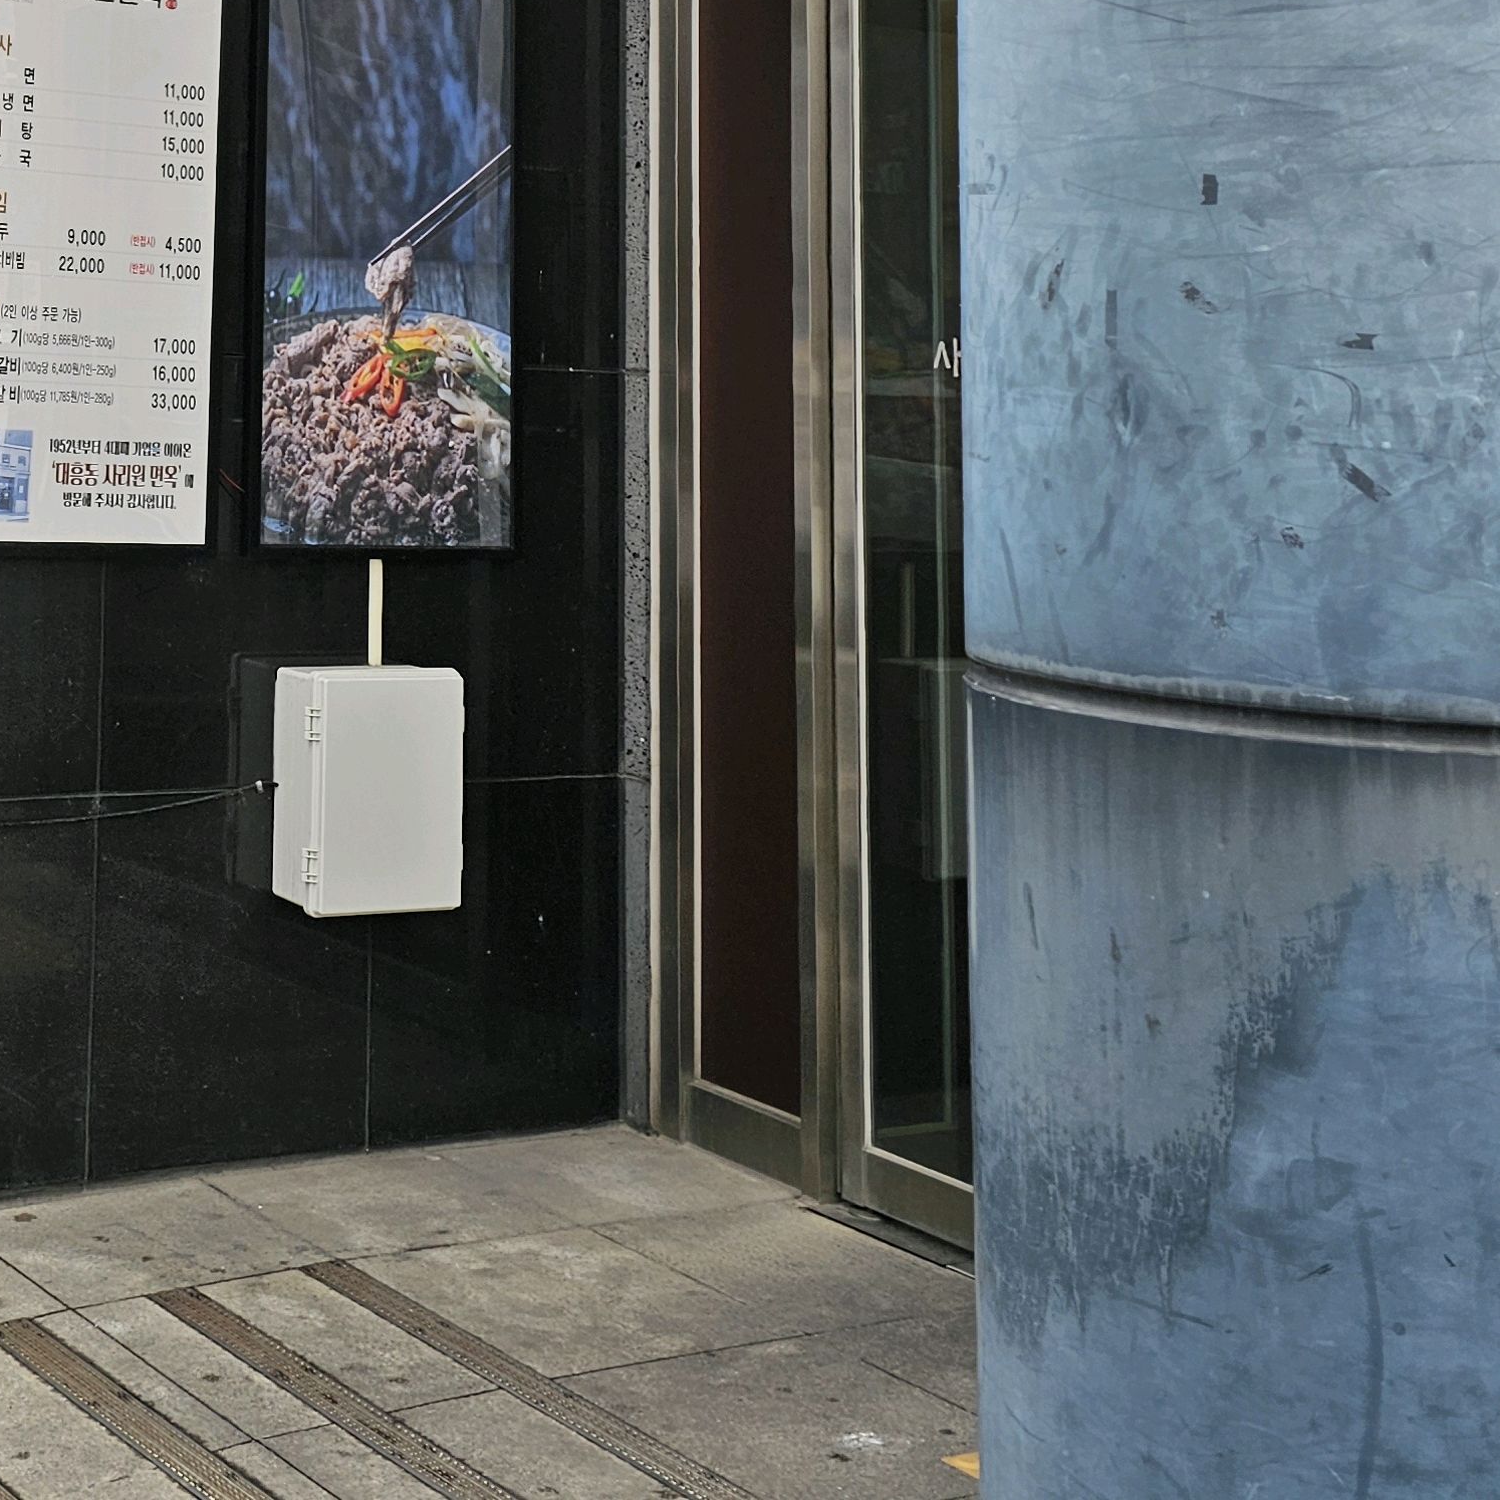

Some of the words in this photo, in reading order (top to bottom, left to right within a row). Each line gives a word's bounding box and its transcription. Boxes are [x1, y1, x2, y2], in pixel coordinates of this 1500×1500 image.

[164, 83, 205, 101] 11,000
[164, 109, 203, 130] 11,000
[162, 136, 204, 156] 15,000
[161, 163, 204, 183] 10,000
[68, 229, 106, 247] 9,000
[165, 237, 201, 254] 4,500
[59, 254, 107, 276] 22,000
[157, 262, 200, 283] 11,000
[1, 303, 19, 322] (2인
[21, 305, 38, 320] 이상
[42, 307, 59, 322] 주문
[62, 308, 81, 324] 가능)
[153, 336, 195, 356] 17,000
[151, 364, 195, 384] 16,000
[150, 393, 196, 412] 33,000
[50, 437, 101, 455] 1952년부터
[101, 464, 146, 487] 사리원
